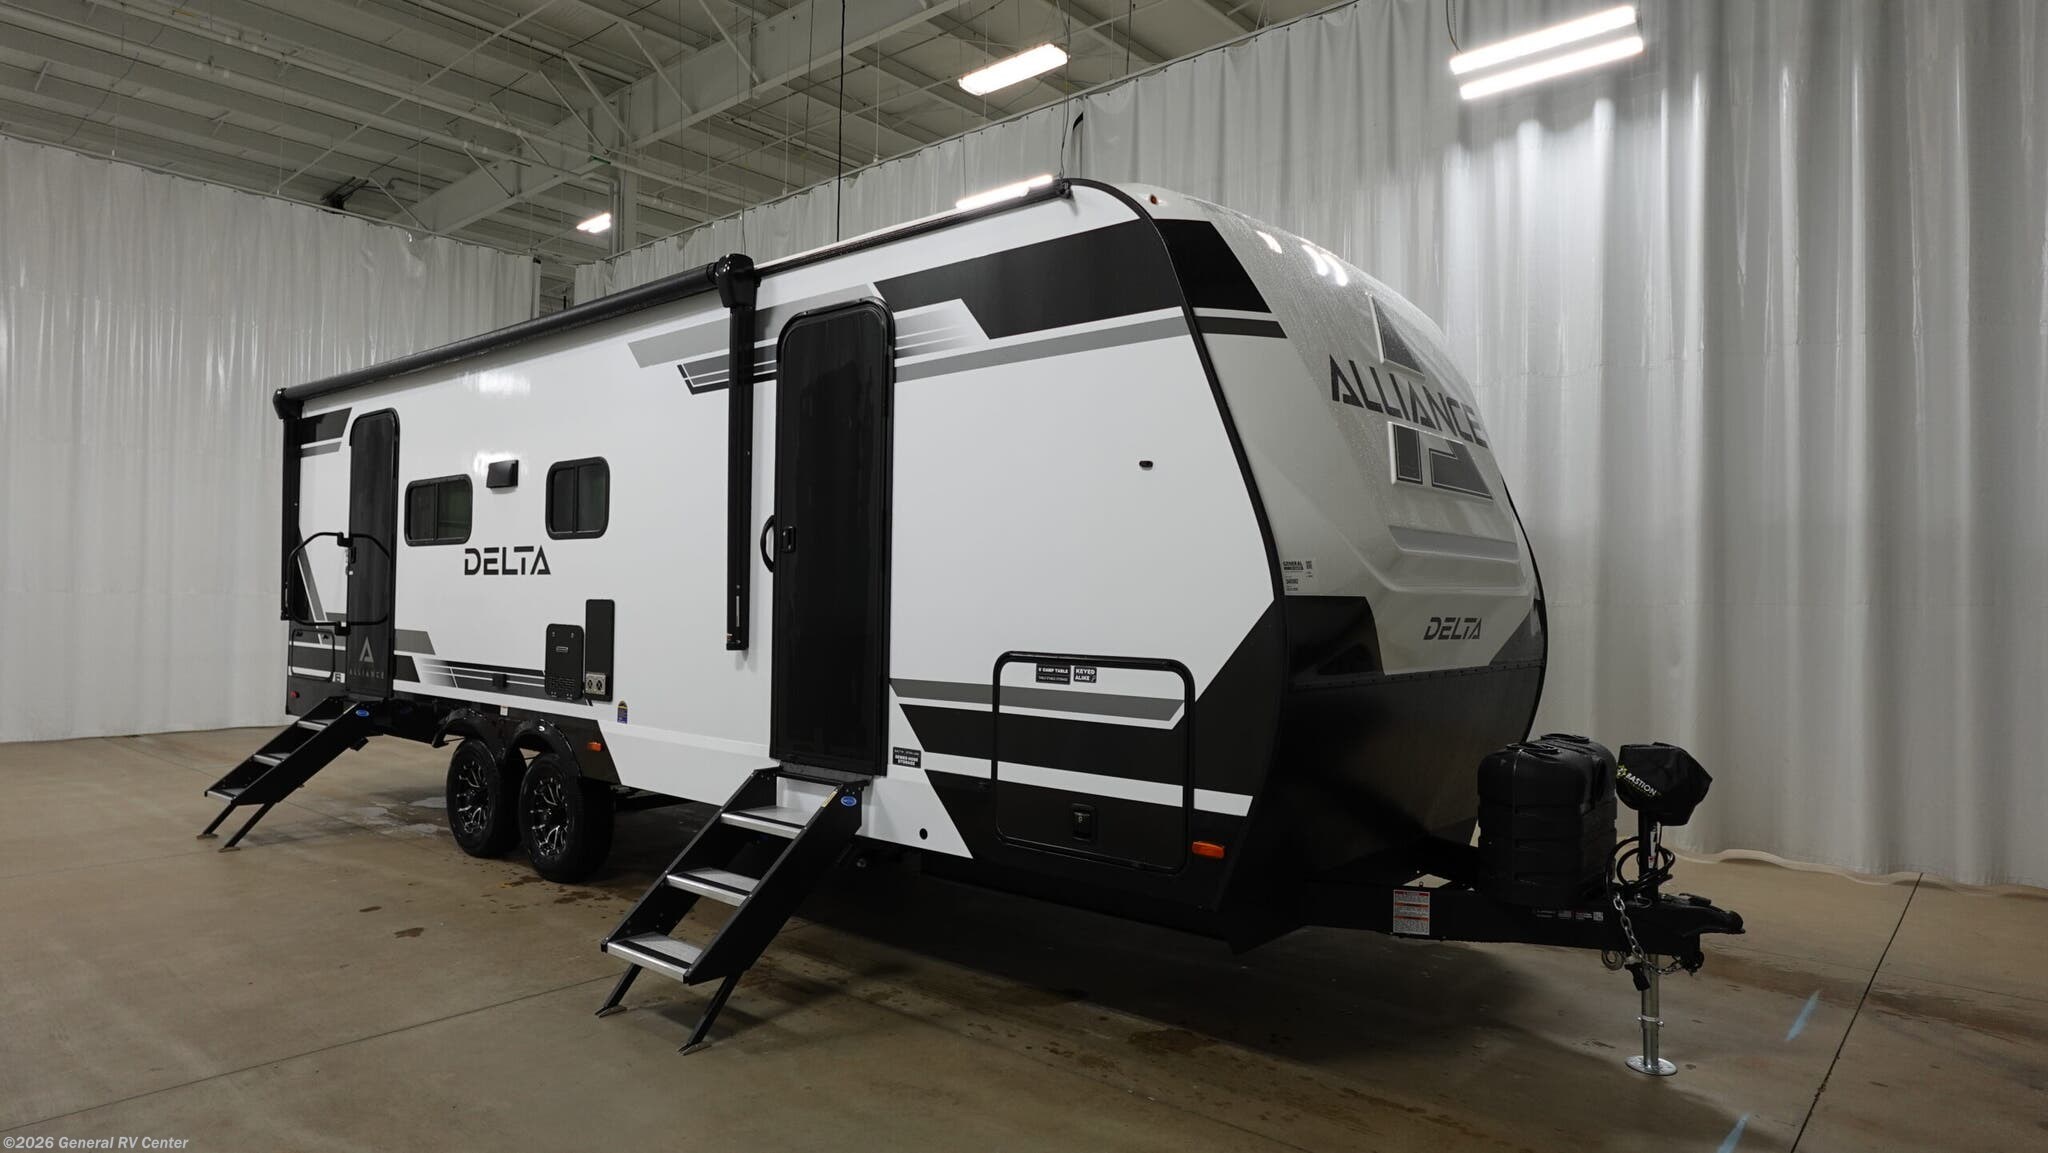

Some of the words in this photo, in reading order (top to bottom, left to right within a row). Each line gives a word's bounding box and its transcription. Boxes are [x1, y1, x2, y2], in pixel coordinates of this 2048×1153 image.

[1329, 354, 1488, 449] ALLIANCE
[464, 545, 551, 576] DELTA
[1423, 617, 1482, 640] DELTA
[350, 668, 385, 679] ALLIANCE
[1625, 772, 1657, 796] BASTION
